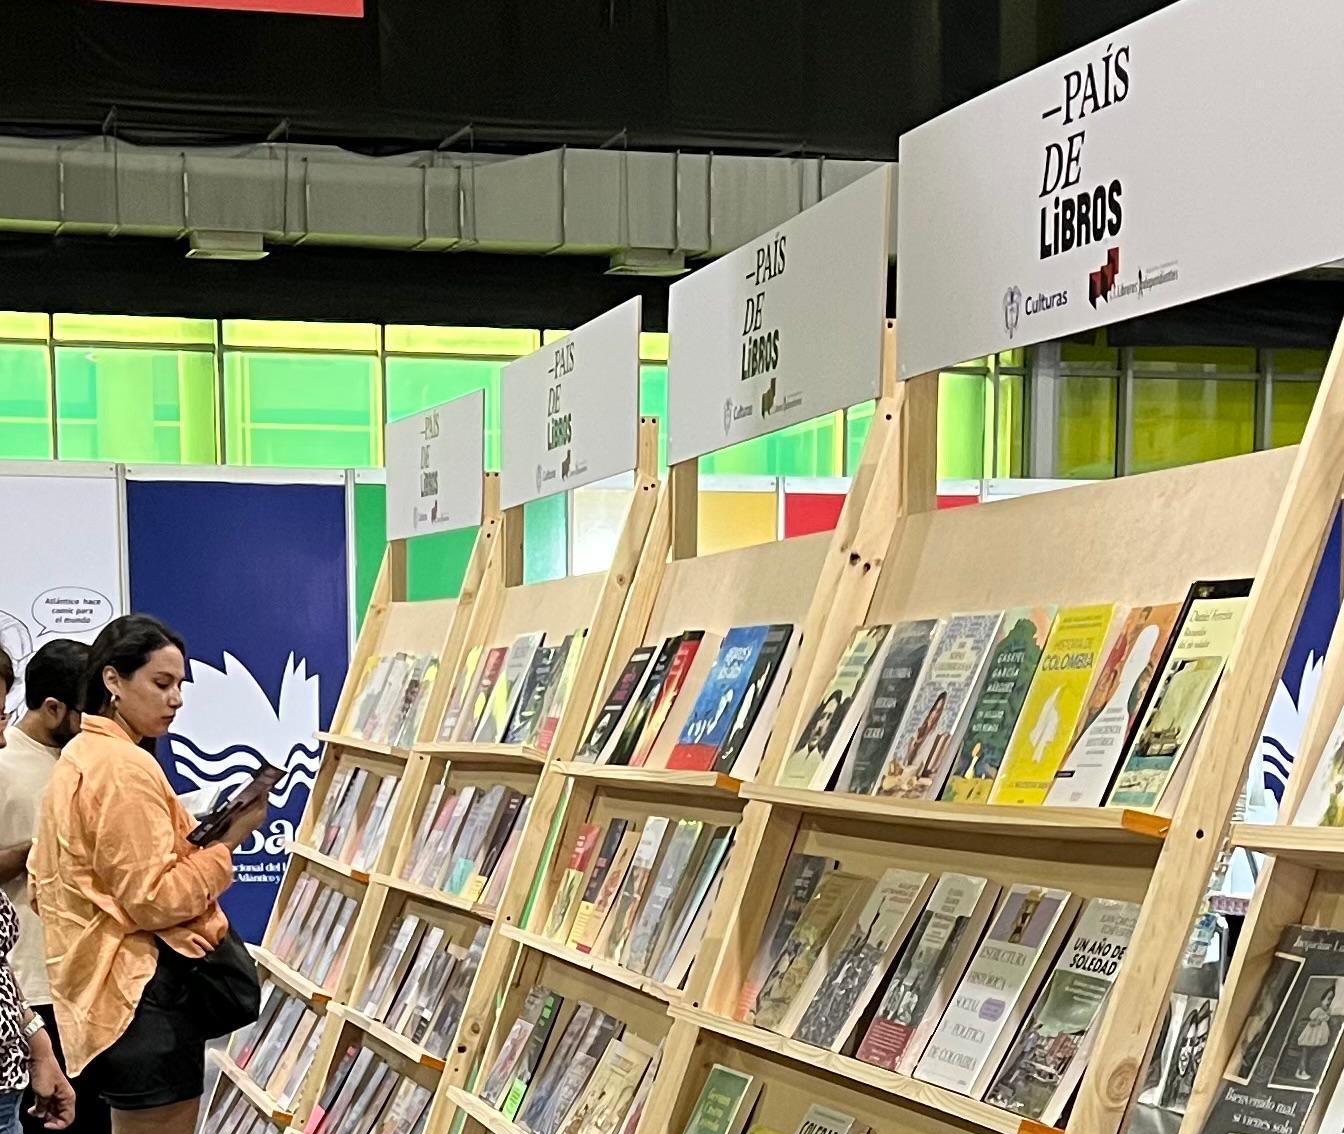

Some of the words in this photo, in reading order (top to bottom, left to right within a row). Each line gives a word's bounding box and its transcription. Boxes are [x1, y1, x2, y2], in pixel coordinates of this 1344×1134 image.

[1039, 130, 1085, 198] DE
[743, 292, 765, 336] DE
[1025, 290, 1068, 315] Culturas
[548, 384, 561, 417] DE
[1042, 652, 1094, 672] COLOMBIA
[1074, 937, 1091, 951] UN
[1089, 938, 1111, 956] AÑO
[1111, 946, 1126, 960] DE
[1069, 954, 1117, 976] SOLEDAD
[1232, 1114, 1241, 1123] si
[1242, 1115, 1271, 1130] vienes
